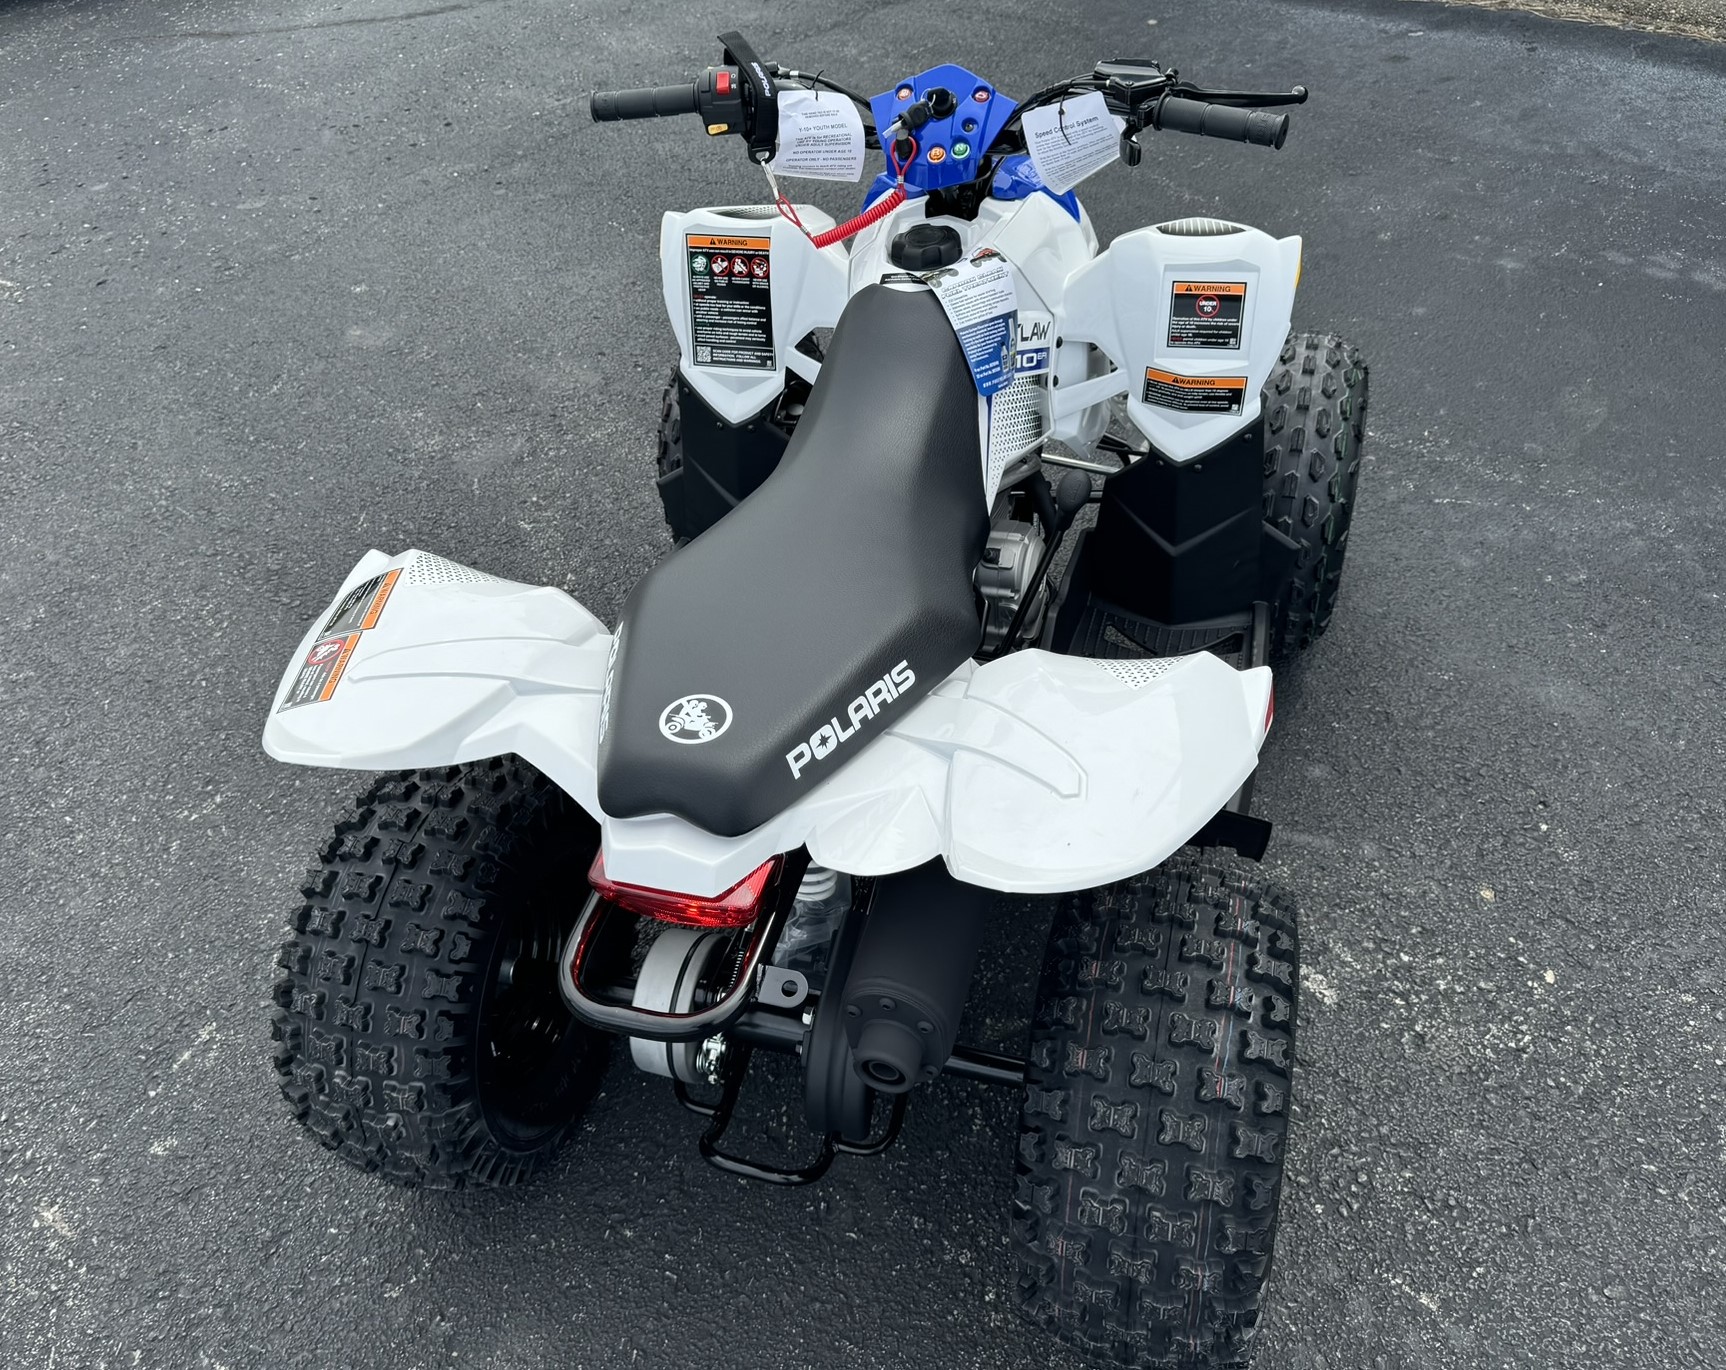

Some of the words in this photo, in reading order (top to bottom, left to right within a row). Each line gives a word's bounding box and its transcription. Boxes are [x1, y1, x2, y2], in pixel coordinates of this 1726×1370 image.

[751, 62, 771, 97] POLARIS
[1034, 128, 1054, 139] Speed
[1076, 116, 1099, 127] System
[717, 238, 748, 247] WARNING
[1193, 284, 1231, 293] WARNING
[1179, 376, 1216, 386] WARNING
[785, 659, 916, 780] POLARIS
